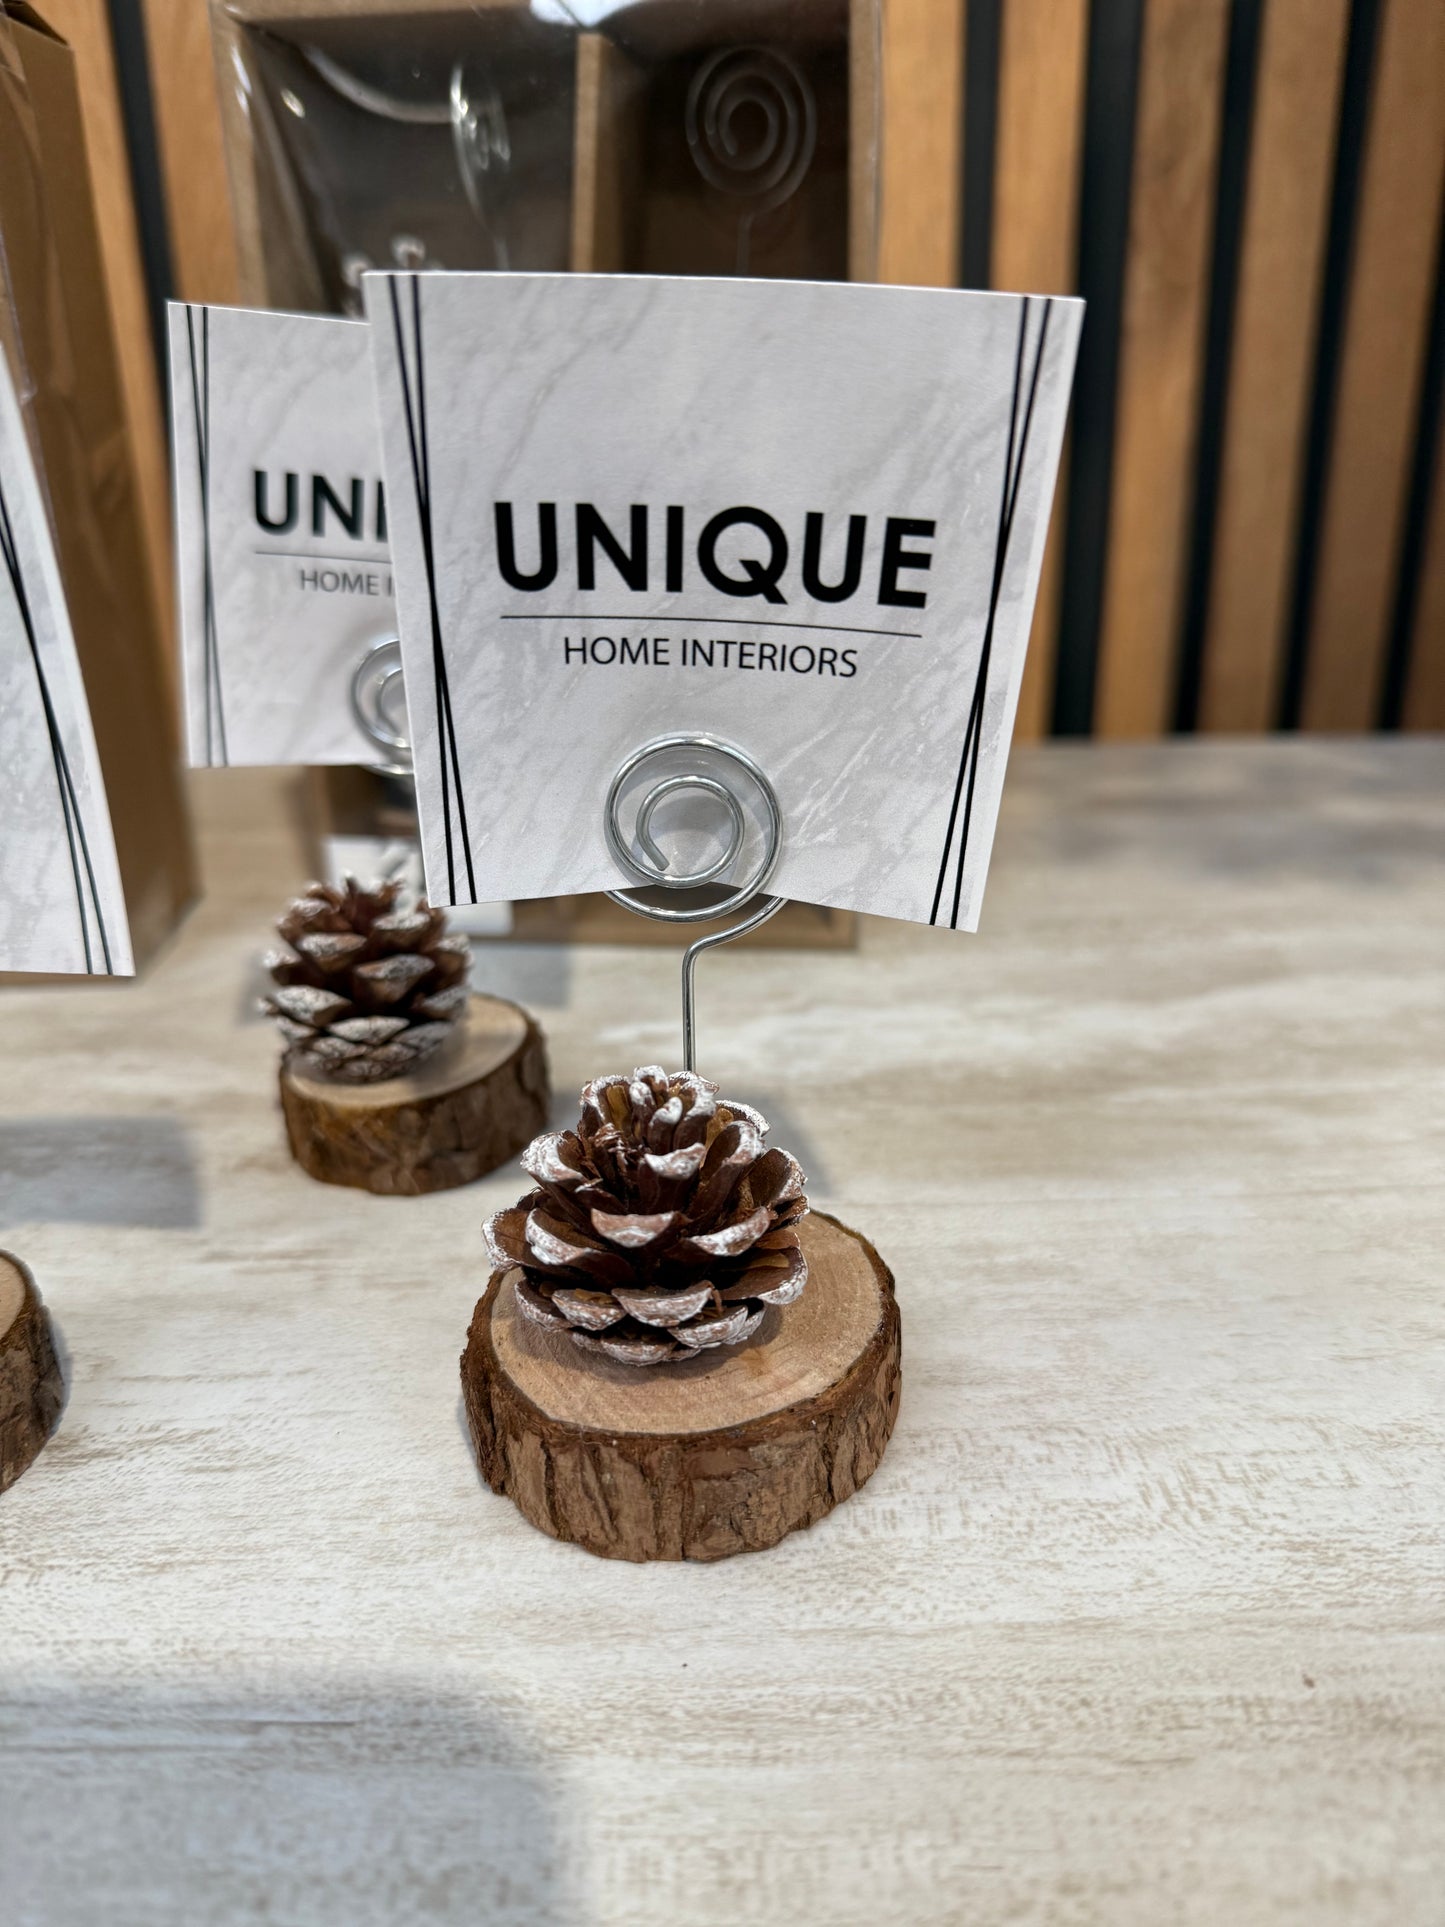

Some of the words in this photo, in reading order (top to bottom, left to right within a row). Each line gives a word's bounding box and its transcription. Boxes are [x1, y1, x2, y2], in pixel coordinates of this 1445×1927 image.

[493, 501, 937, 609] UNIQUE
[299, 568, 379, 596] HOME
[564, 636, 671, 666] HOME
[681, 638, 858, 678] INTERIORS
